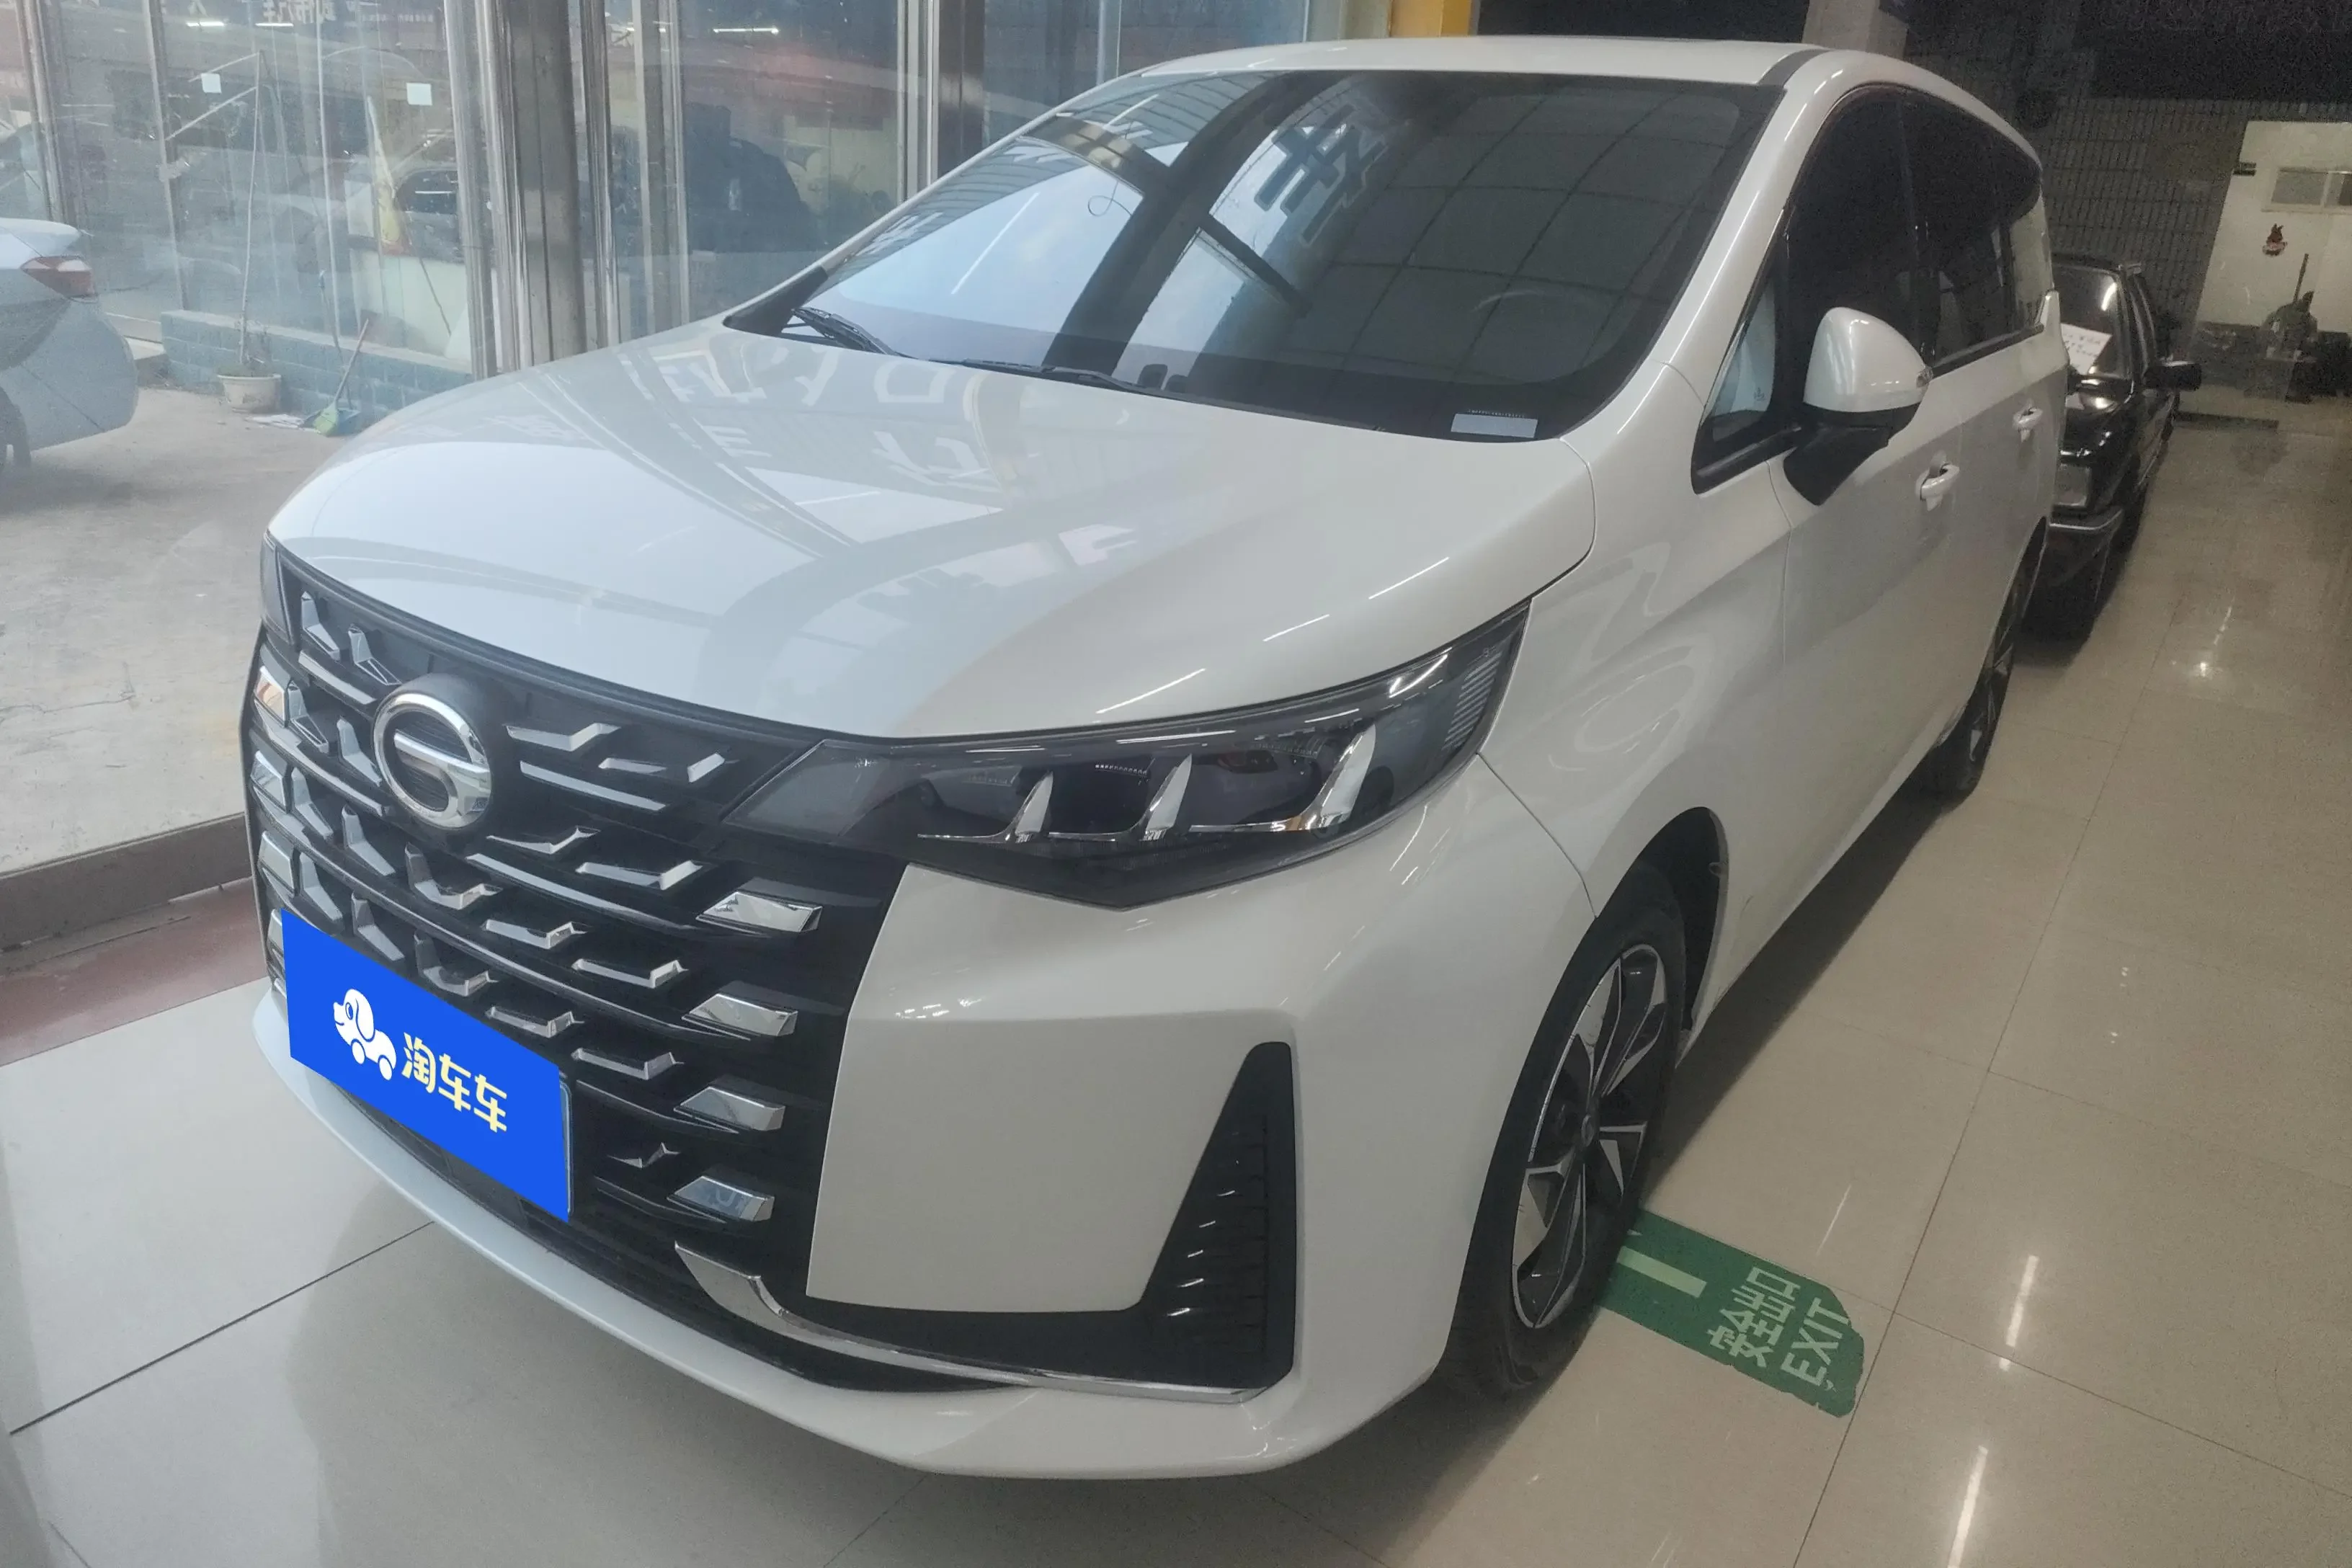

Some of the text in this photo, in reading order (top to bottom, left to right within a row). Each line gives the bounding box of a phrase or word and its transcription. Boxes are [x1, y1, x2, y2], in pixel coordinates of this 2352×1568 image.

[1707, 1267, 1801, 1368] 安全出口
[1781, 1297, 1850, 1386] EXIT
